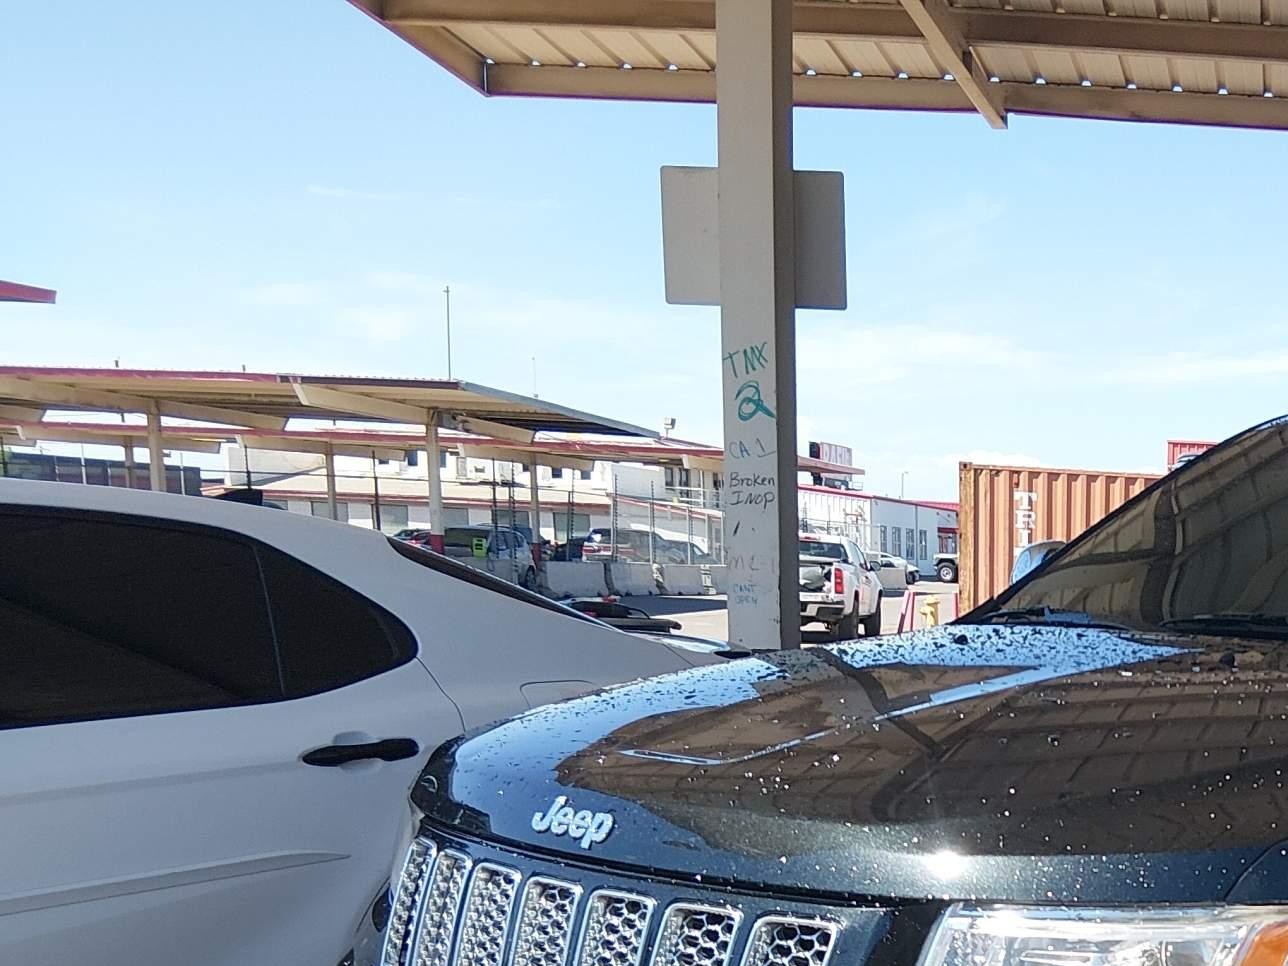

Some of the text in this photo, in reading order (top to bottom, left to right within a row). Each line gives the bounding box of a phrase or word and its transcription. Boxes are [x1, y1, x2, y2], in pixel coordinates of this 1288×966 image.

[729, 472, 776, 488] Broken
[729, 492, 776, 510] INOP
[531, 795, 614, 849] Jeep
